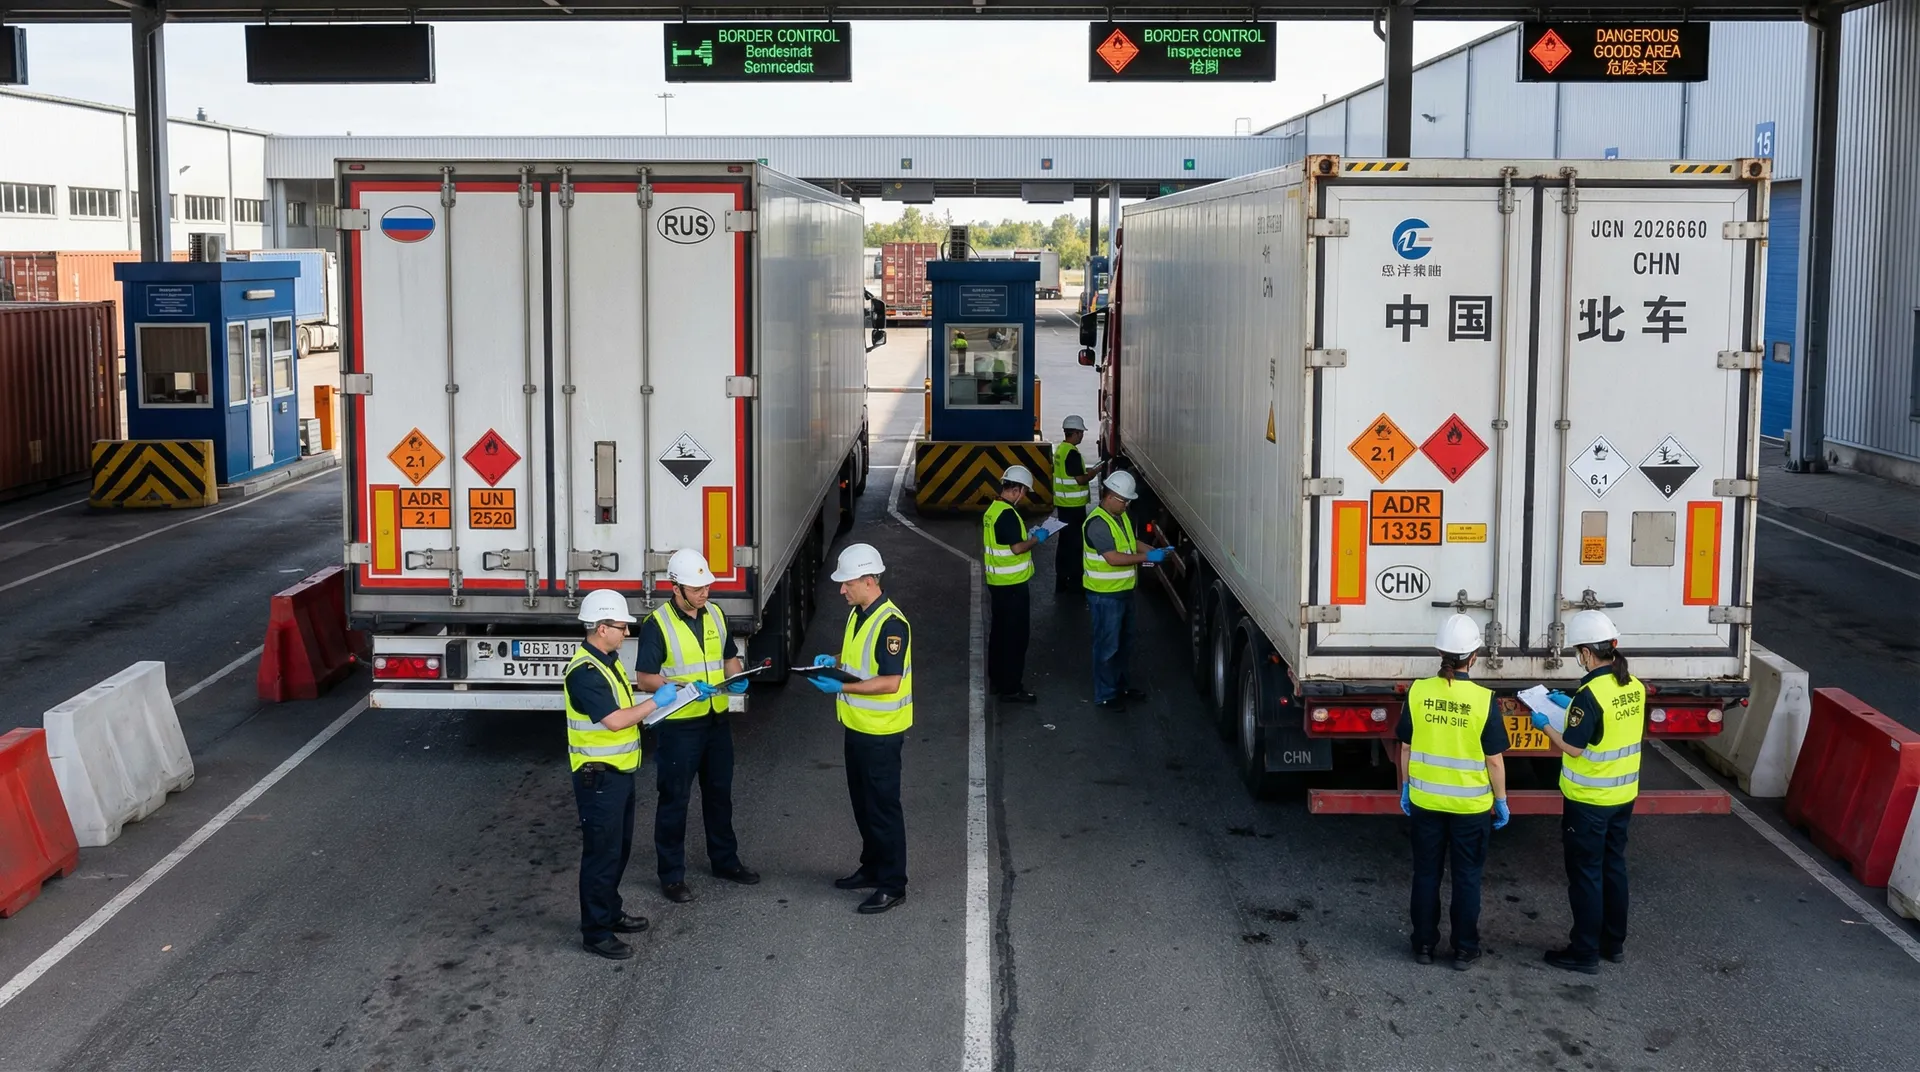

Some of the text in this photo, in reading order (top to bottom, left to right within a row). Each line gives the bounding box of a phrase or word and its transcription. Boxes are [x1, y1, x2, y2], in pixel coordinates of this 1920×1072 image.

[718, 29, 840, 42] BORDER CONTROL
[1144, 29, 1266, 42] BORDER CONTROL
[1596, 29, 1679, 42] DANGEROUS
[1593, 45, 1681, 58] GOODS AREA
[1756, 131, 1771, 156] 15
[664, 215, 708, 236] RUS
[1633, 219, 1707, 239] 2026660
[1633, 251, 1680, 275] CHN
[1385, 293, 1493, 342] 中国
[1370, 446, 1395, 461] 2.1
[405, 455, 426, 468] 2.1
[1590, 474, 1608, 485] 6.1
[1664, 484, 1671, 493] 8
[407, 492, 443, 505] ADR
[480, 492, 504, 505] UN
[1382, 496, 1431, 514] ADR
[415, 512, 436, 525] 2.1
[473, 512, 512, 525] 2520
[1381, 522, 1432, 540] 1335
[1381, 573, 1423, 594] CHN
[1424, 713, 1448, 725] CHN
[1283, 750, 1312, 764] CHN
